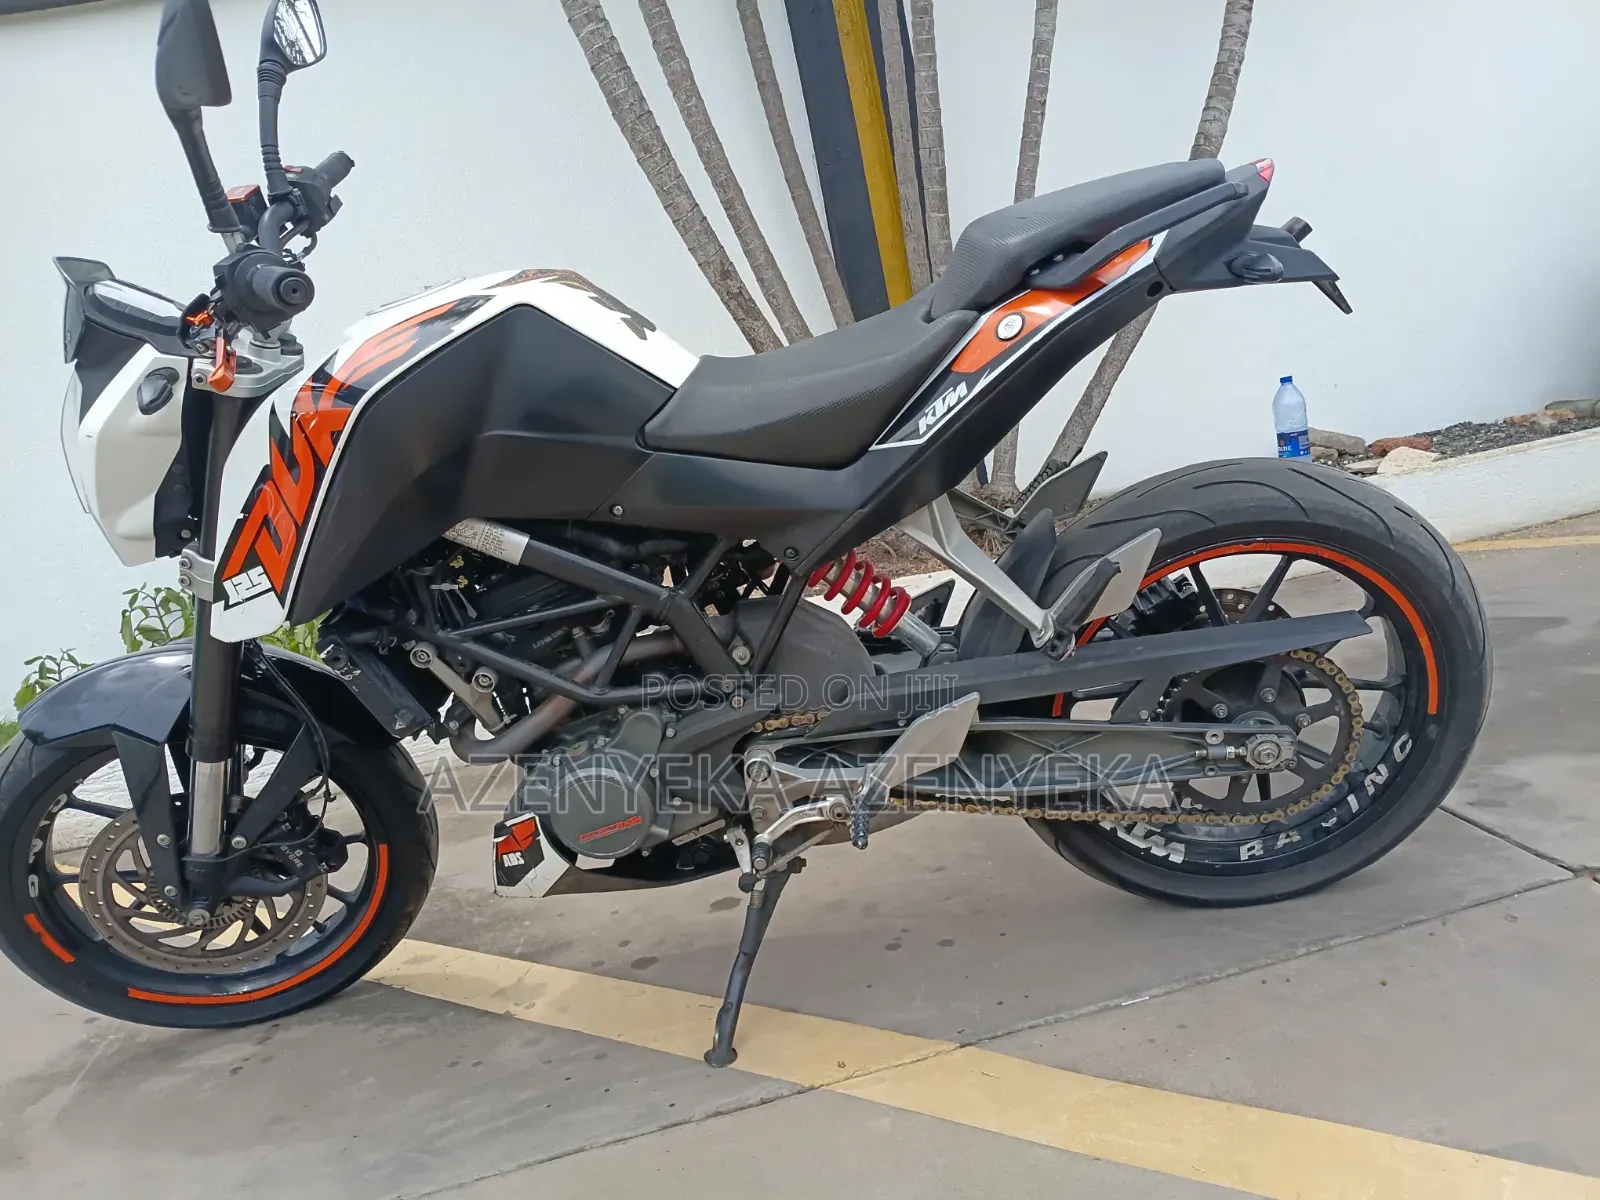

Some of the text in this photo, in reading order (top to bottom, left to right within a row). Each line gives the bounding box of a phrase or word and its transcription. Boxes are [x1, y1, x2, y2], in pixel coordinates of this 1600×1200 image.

[918, 381, 968, 436] KTM
[223, 565, 273, 606] 125
[280, 844, 304, 869] BYBRE
[502, 851, 525, 867] ABS
